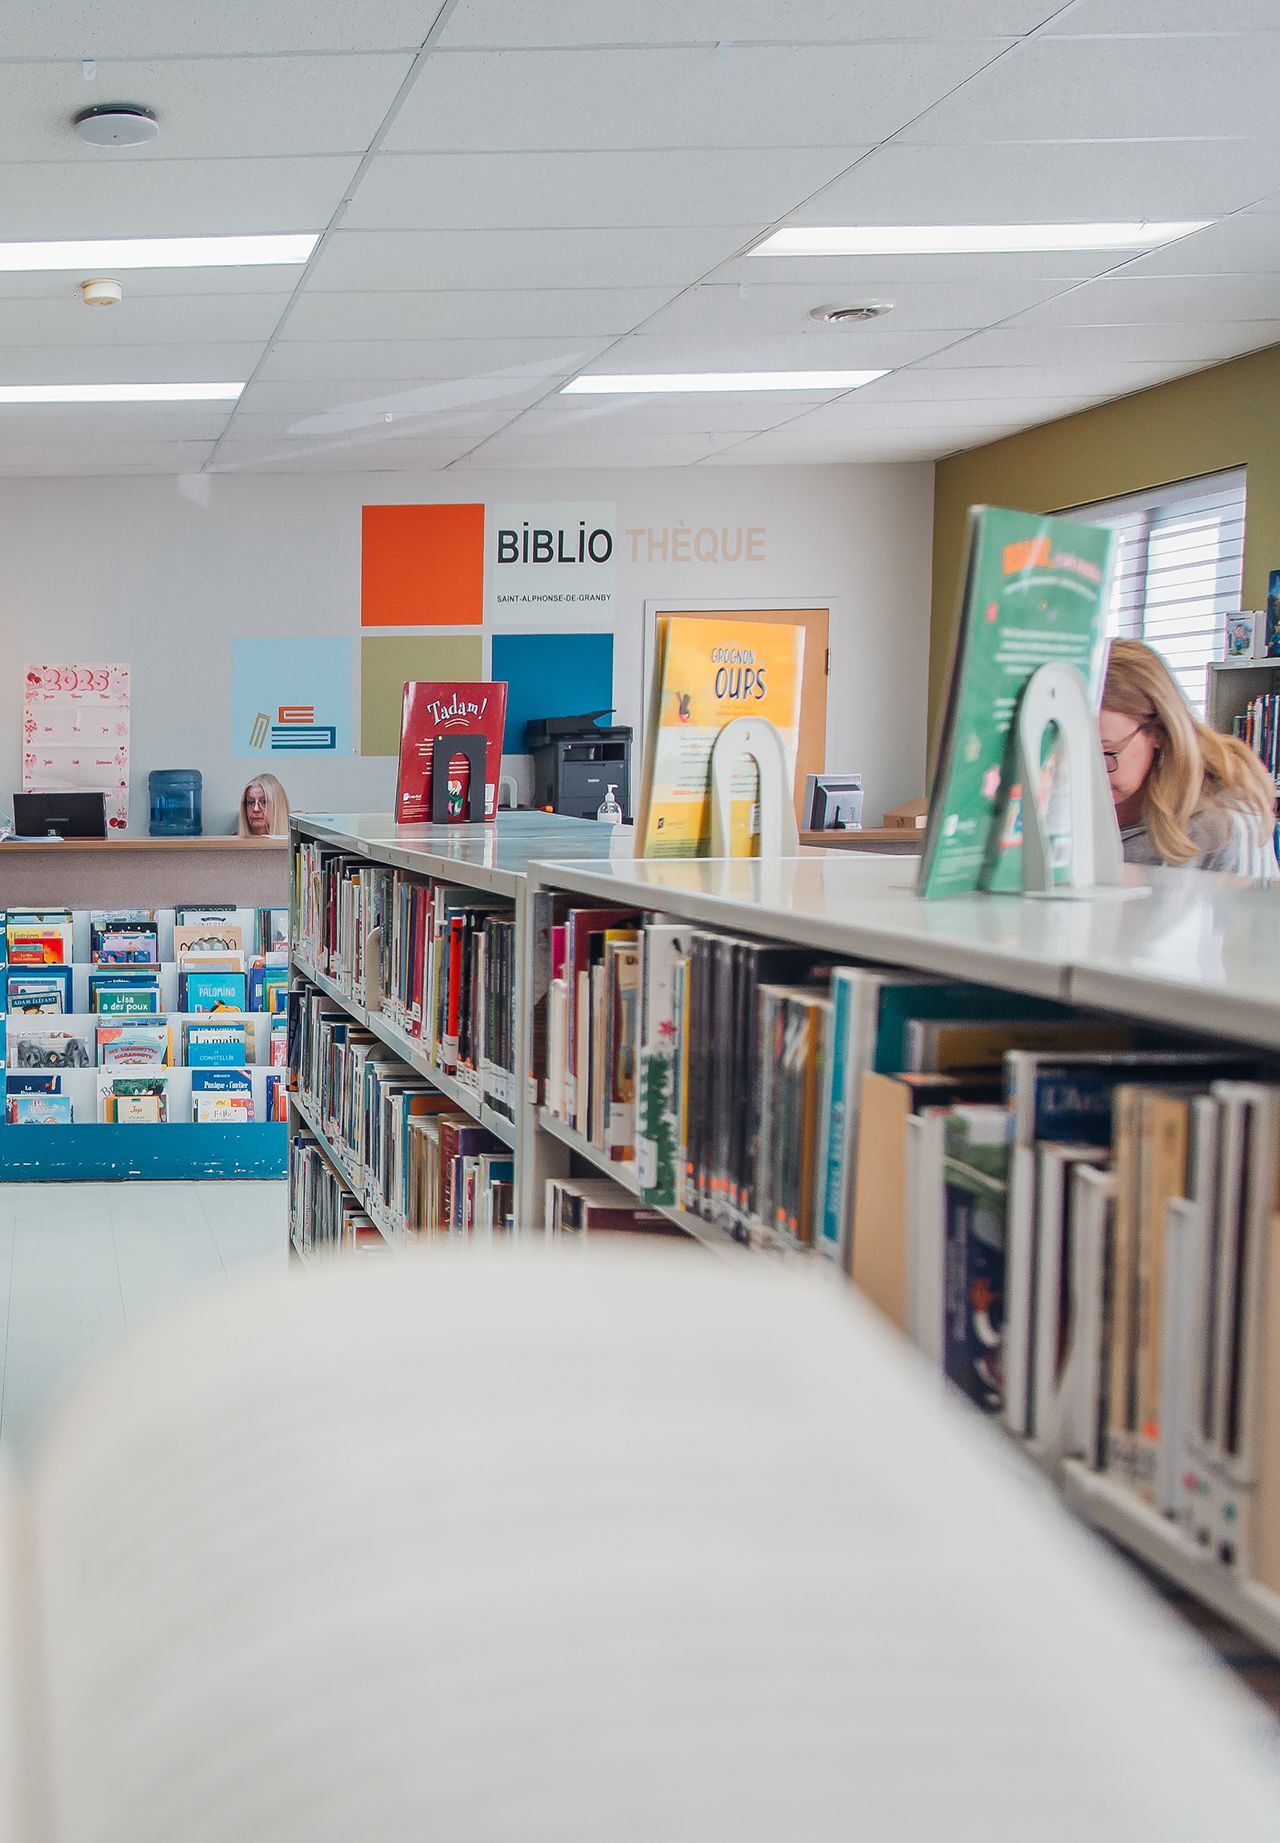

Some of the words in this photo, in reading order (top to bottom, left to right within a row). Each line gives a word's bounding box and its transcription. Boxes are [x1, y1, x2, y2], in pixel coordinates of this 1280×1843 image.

[625, 520, 766, 563] THÈQUE
[497, 593, 611, 603] SAINT-ALPHONSE-DE-GRANBY
[711, 647, 755, 665] GROGNON
[43, 669, 110, 691] 2025
[427, 692, 488, 725] Tadam!
[13, 998, 30, 1006] ADAM
[116, 995, 134, 1004] Lisa
[110, 1002, 124, 1011] des
[126, 1003, 148, 1013] poux
[204, 1081, 225, 1089] Panique
